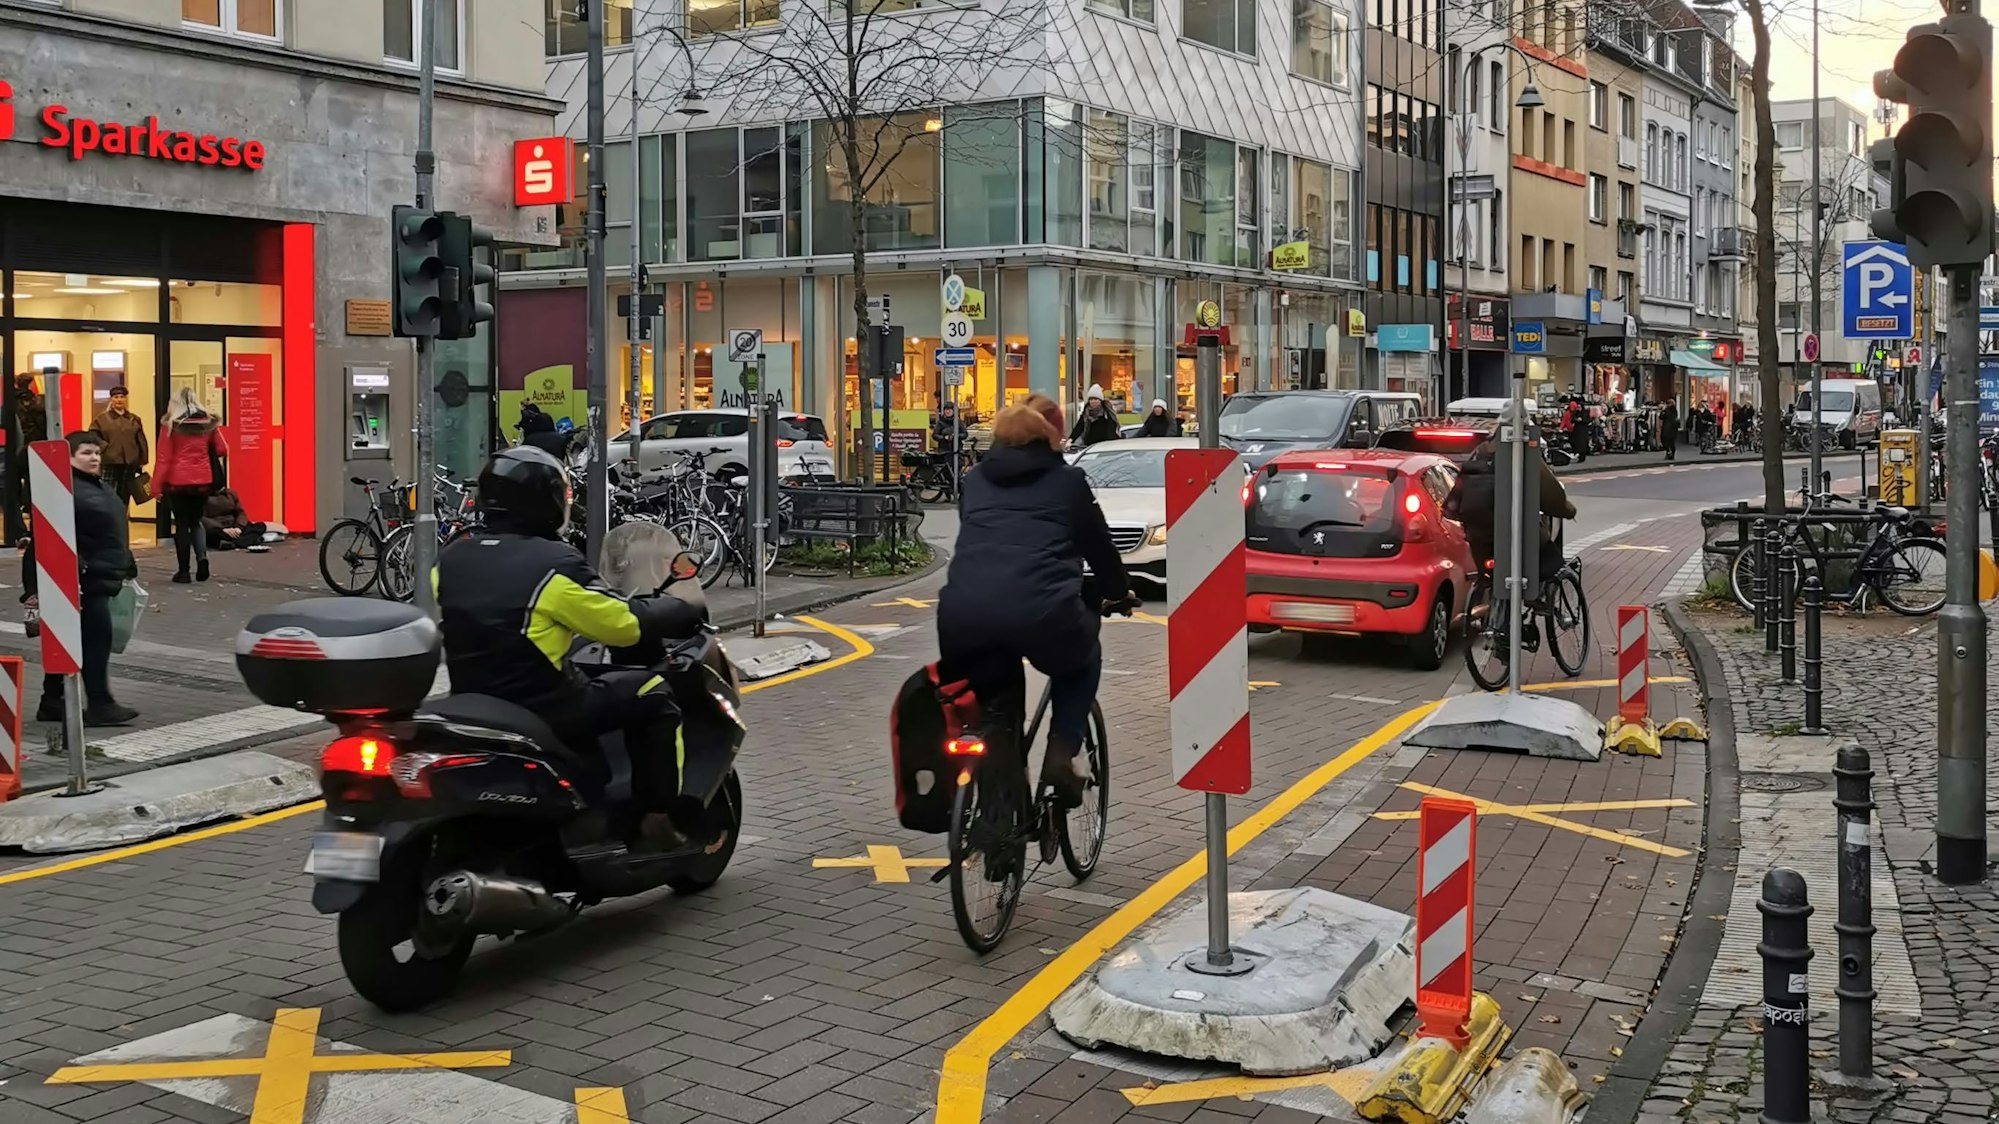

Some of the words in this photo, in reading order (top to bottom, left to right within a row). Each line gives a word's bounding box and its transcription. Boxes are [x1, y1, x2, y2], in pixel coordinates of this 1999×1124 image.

[41, 104, 265, 169] Sparkasse
[1860, 262, 1894, 309] P
[948, 321, 966, 337] 30
[1861, 319, 1895, 328] BESETZT
[740, 337, 752, 348] 20
[1516, 332, 1541, 342] TEDi
[532, 389, 566, 401] ALNATURA
